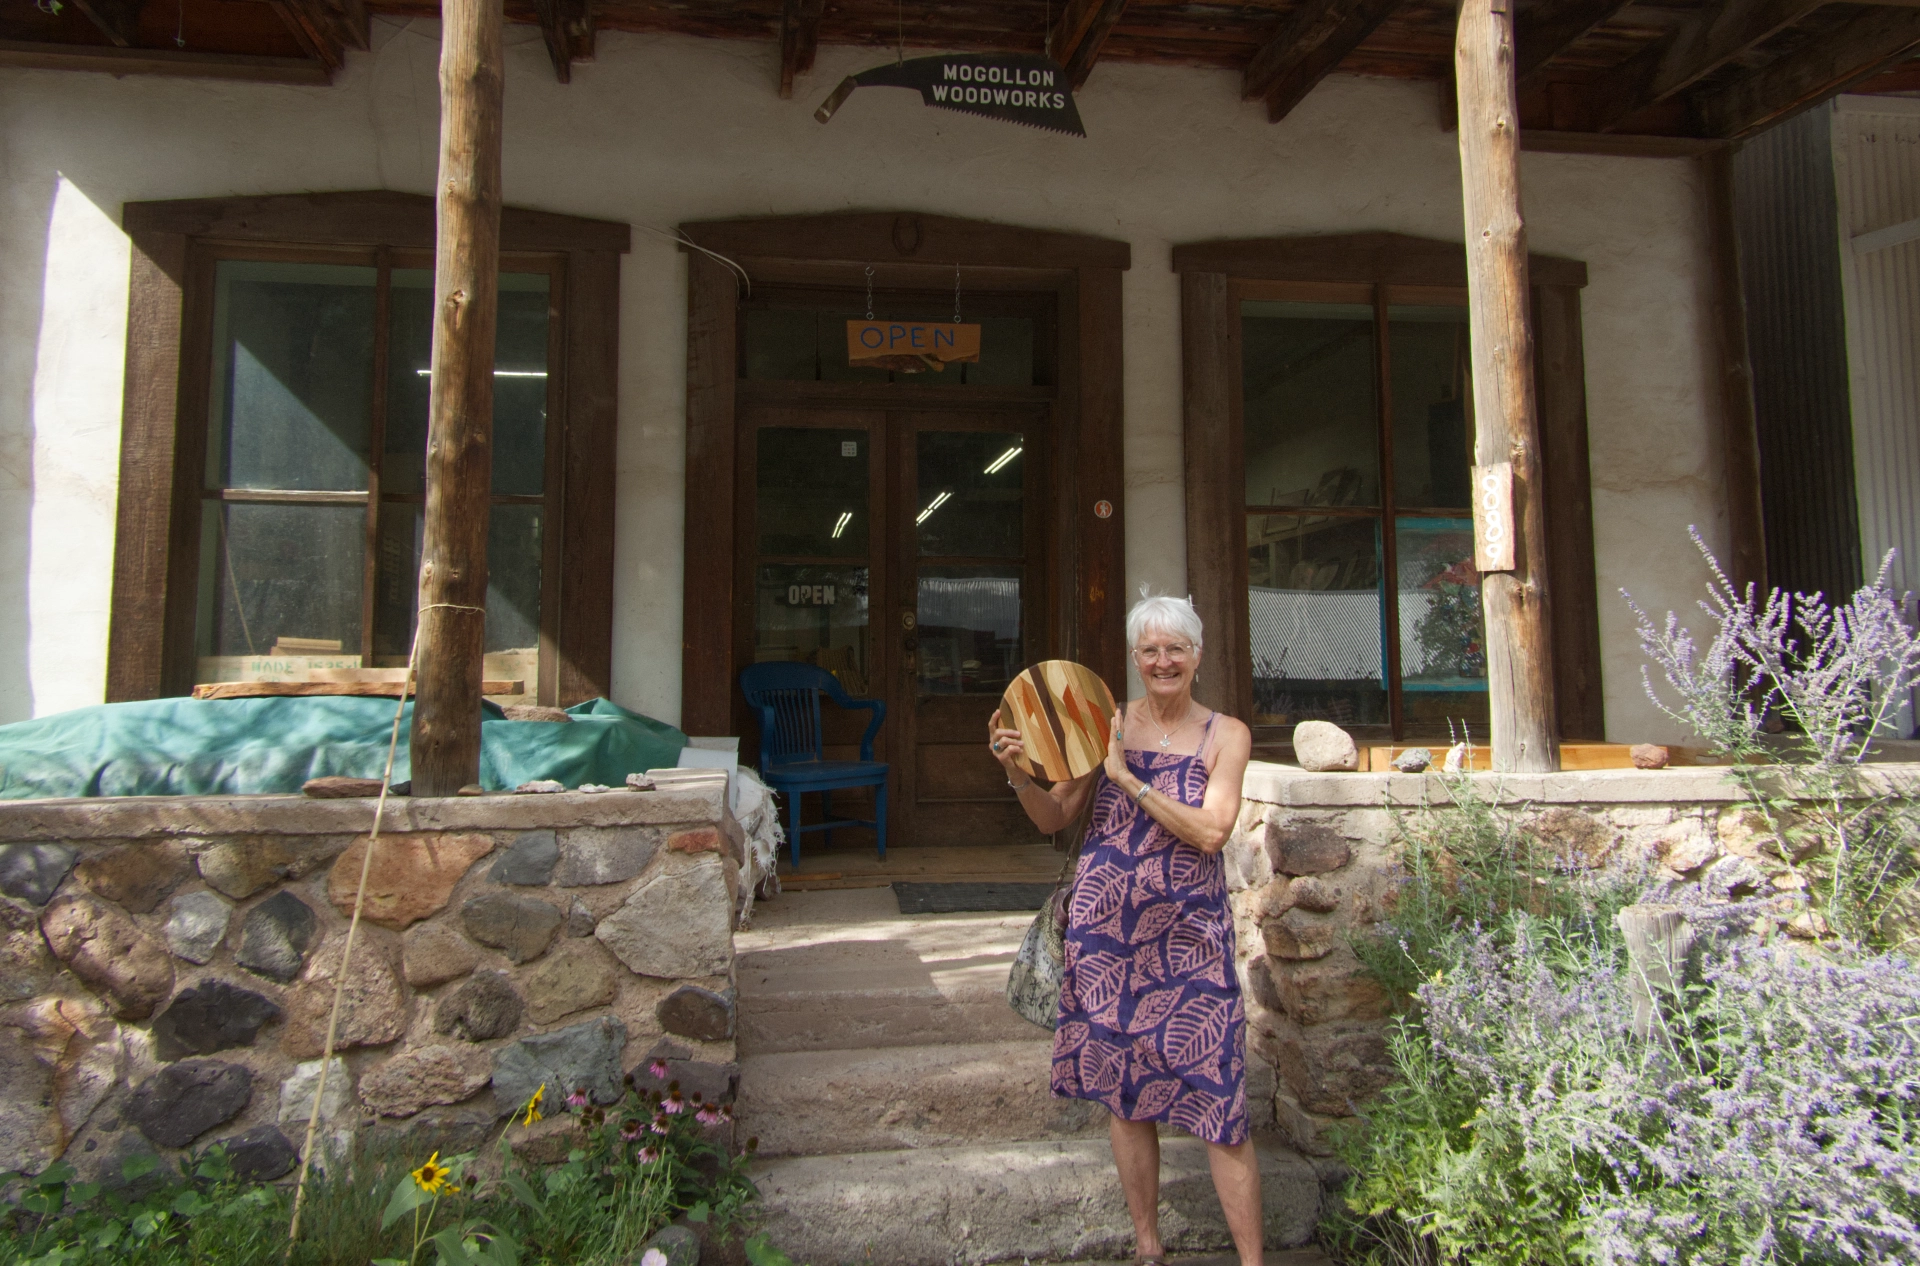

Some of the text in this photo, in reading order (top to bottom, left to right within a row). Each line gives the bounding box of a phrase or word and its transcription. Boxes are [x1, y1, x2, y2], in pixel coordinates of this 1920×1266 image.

[944, 64, 1054, 87] MOGOLLON
[933, 85, 1065, 109] WOODWORKS
[860, 324, 955, 349] OPEN
[1482, 475, 1503, 569] 889
[789, 585, 835, 605] OPEN
